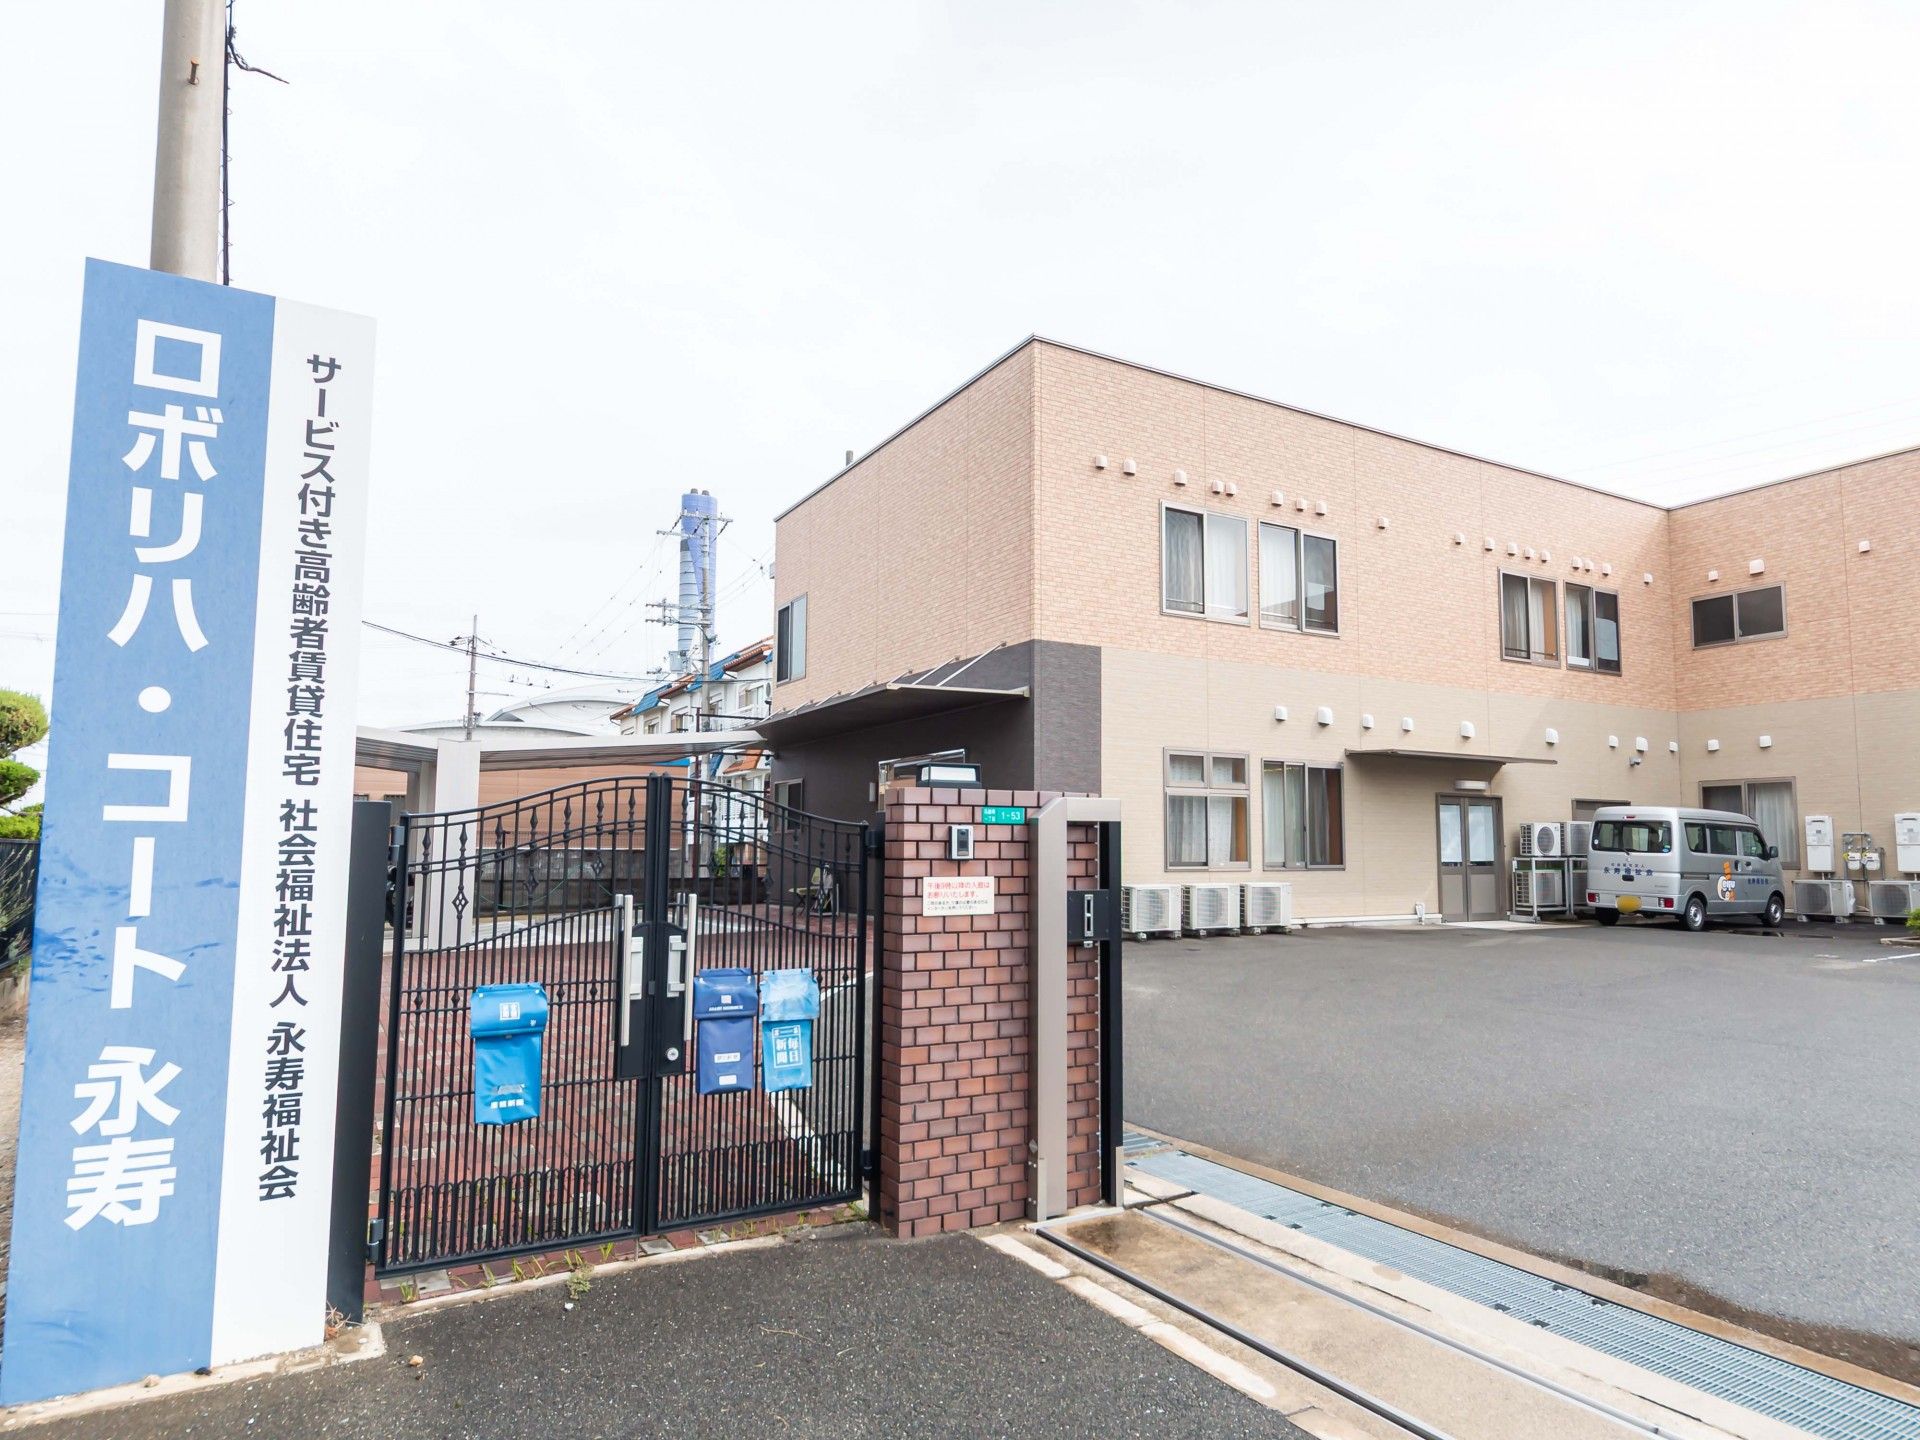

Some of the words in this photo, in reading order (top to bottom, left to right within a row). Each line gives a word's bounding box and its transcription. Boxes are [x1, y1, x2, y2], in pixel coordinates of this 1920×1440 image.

[282, 354, 342, 786] サービス付き高齢者賃貸住宅
[269, 799, 318, 1008] 社会福祉法人
[1001, 811, 1021, 821] 1-53
[64, 1045, 182, 1231] 永寿
[259, 1021, 306, 1202] 永寿福祉会
